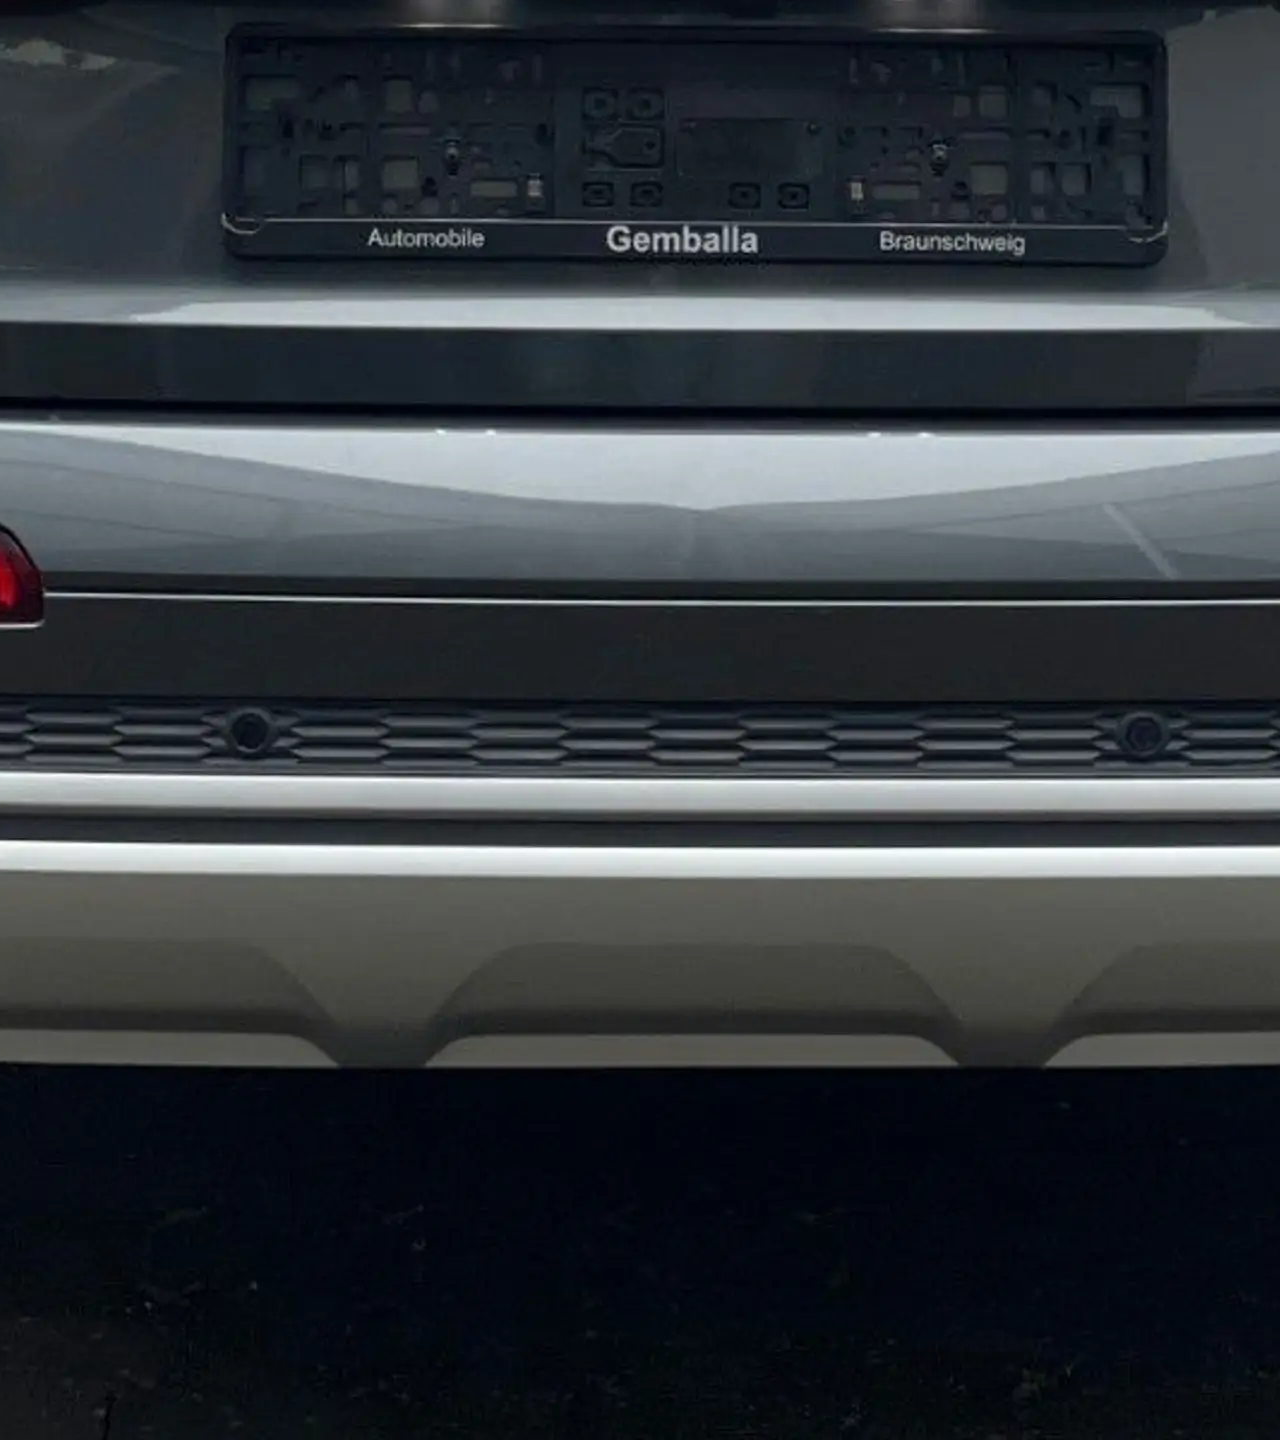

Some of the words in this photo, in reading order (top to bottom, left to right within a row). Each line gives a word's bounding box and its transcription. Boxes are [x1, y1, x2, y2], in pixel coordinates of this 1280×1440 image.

[368, 227, 486, 248] Automobile
[606, 224, 759, 253] Gemballa
[879, 231, 1026, 255] Braunschweig
